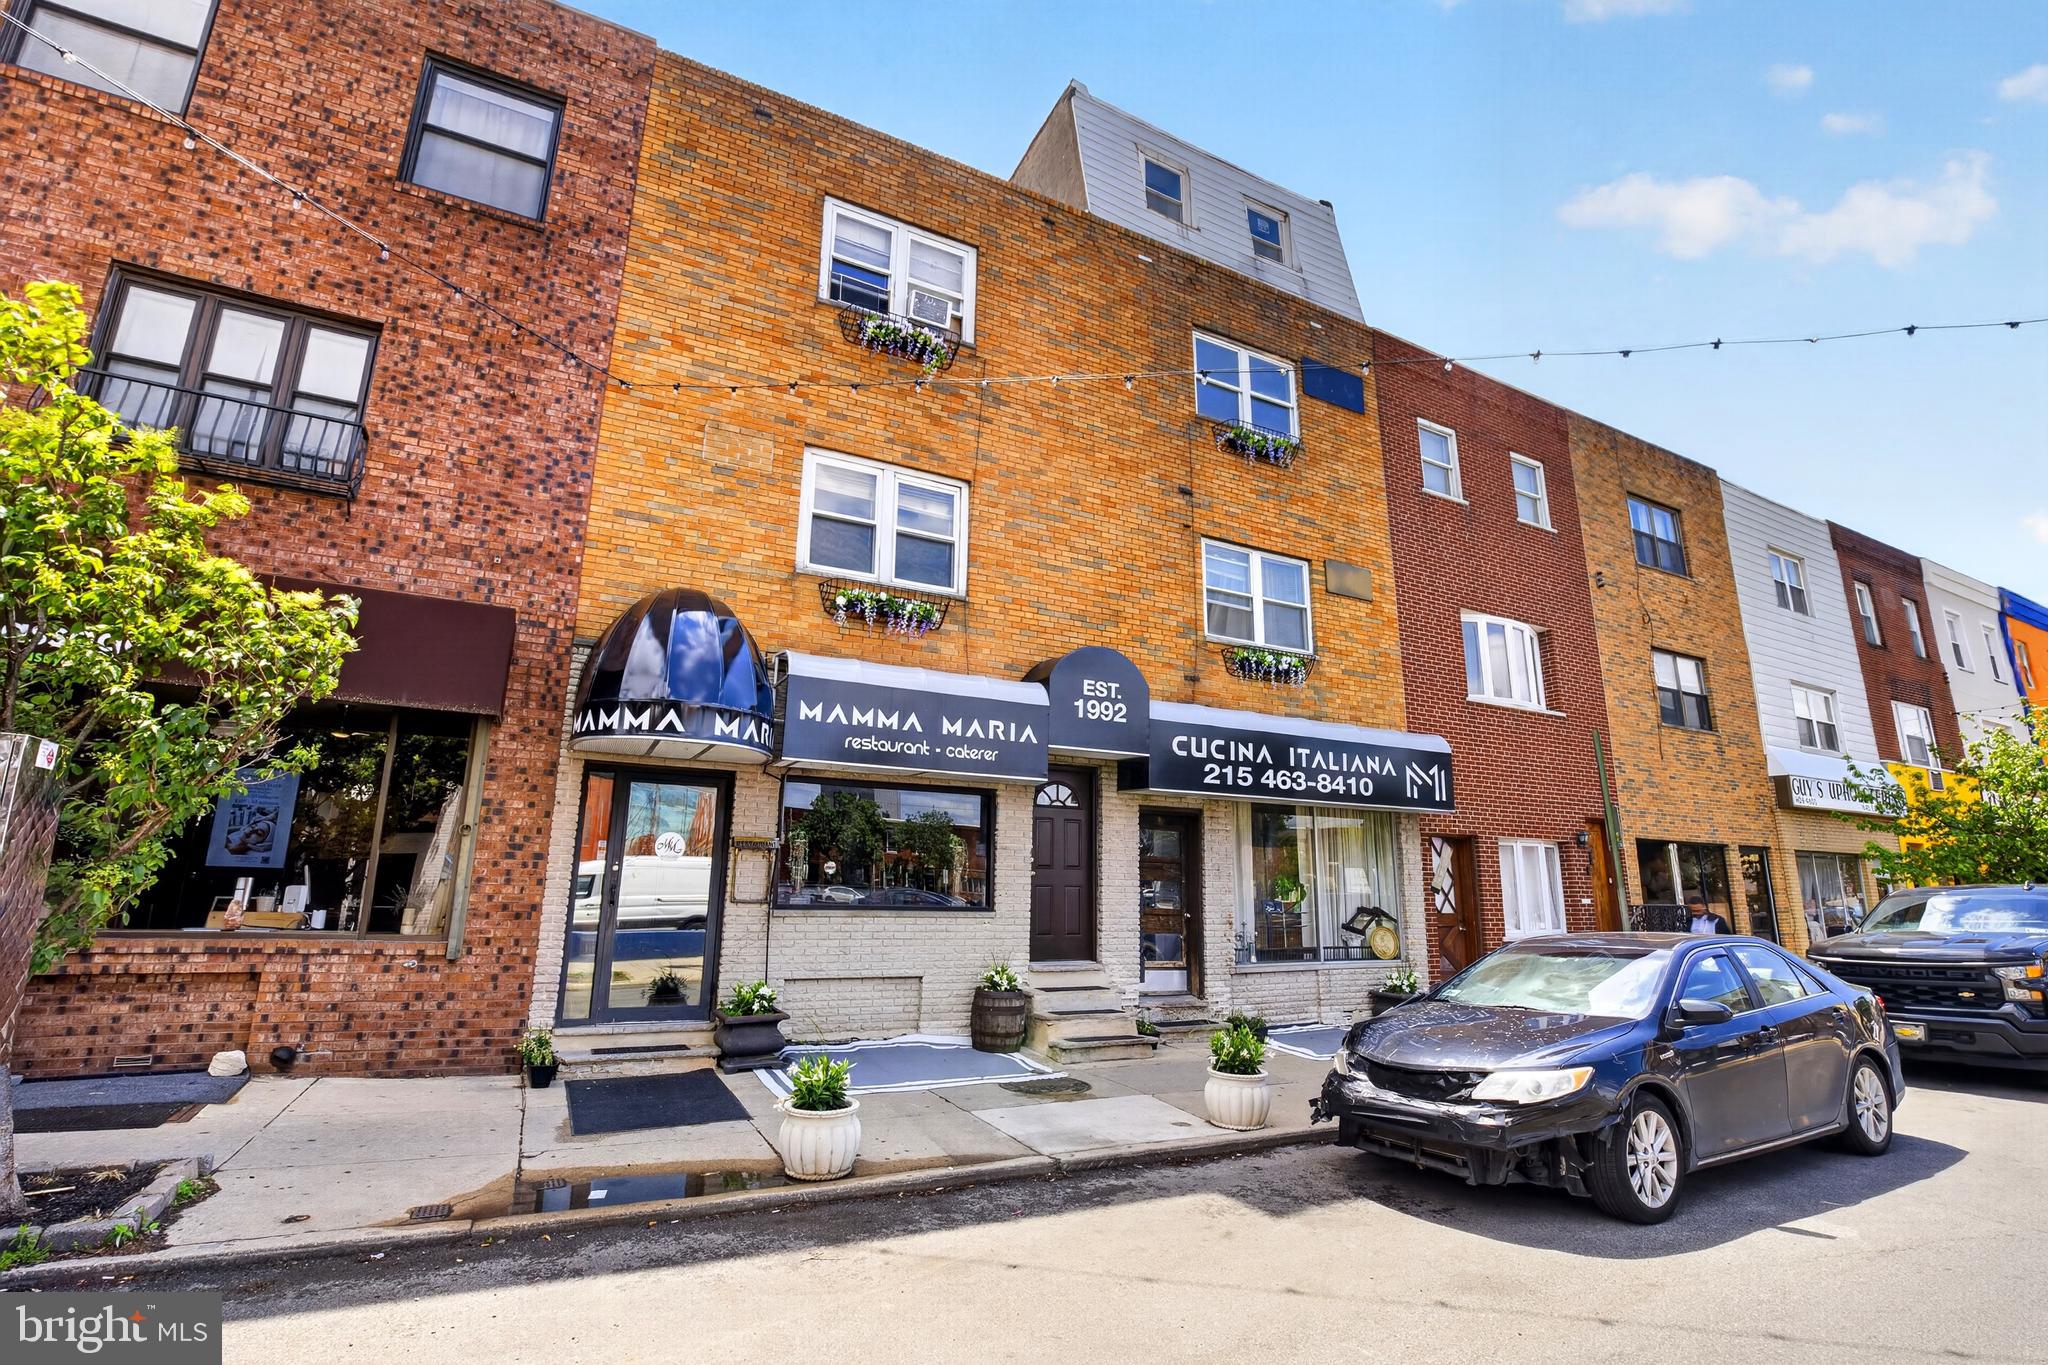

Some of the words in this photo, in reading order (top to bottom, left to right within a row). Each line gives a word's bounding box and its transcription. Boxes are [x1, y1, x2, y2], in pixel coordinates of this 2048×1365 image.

[1083, 680, 1122, 699] EST.
[573, 707, 685, 734] MAMMA
[800, 699, 923, 732] MAMMA
[942, 716, 1038, 744] MARIA
[1073, 699, 1127, 722] 1992
[845, 736, 930, 756] restaurant
[946, 747, 999, 762] caterer
[1172, 735, 1273, 765] CUCINA
[1290, 747, 1397, 776] ITALIANA
[1203, 763, 1254, 787] 215
[1260, 769, 1374, 797] 463-8410
